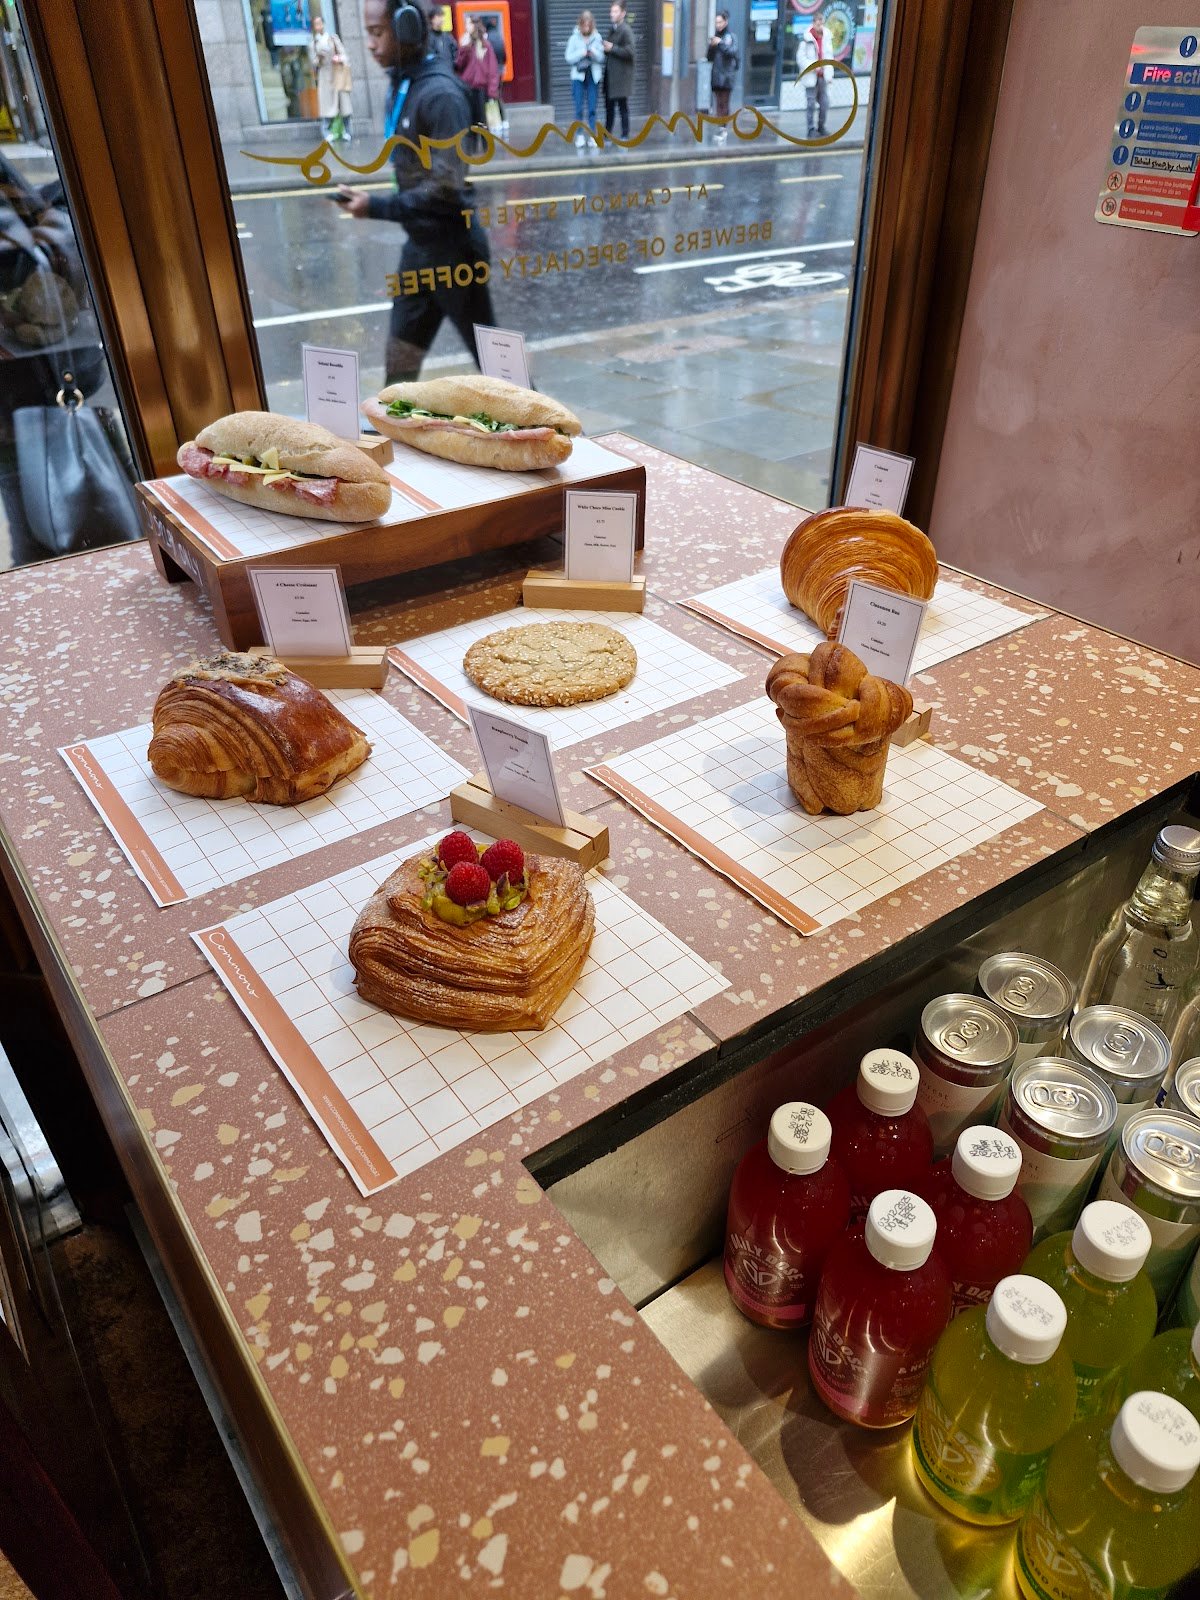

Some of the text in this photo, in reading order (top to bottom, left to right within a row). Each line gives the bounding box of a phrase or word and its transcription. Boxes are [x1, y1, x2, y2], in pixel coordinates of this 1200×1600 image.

[1142, 66, 1172, 83] Fire
[71, 747, 105, 790] Commons
[596, 768, 656, 813] Commons
[209, 932, 260, 999] Commons
[765, 1254, 804, 1281] DOSE
